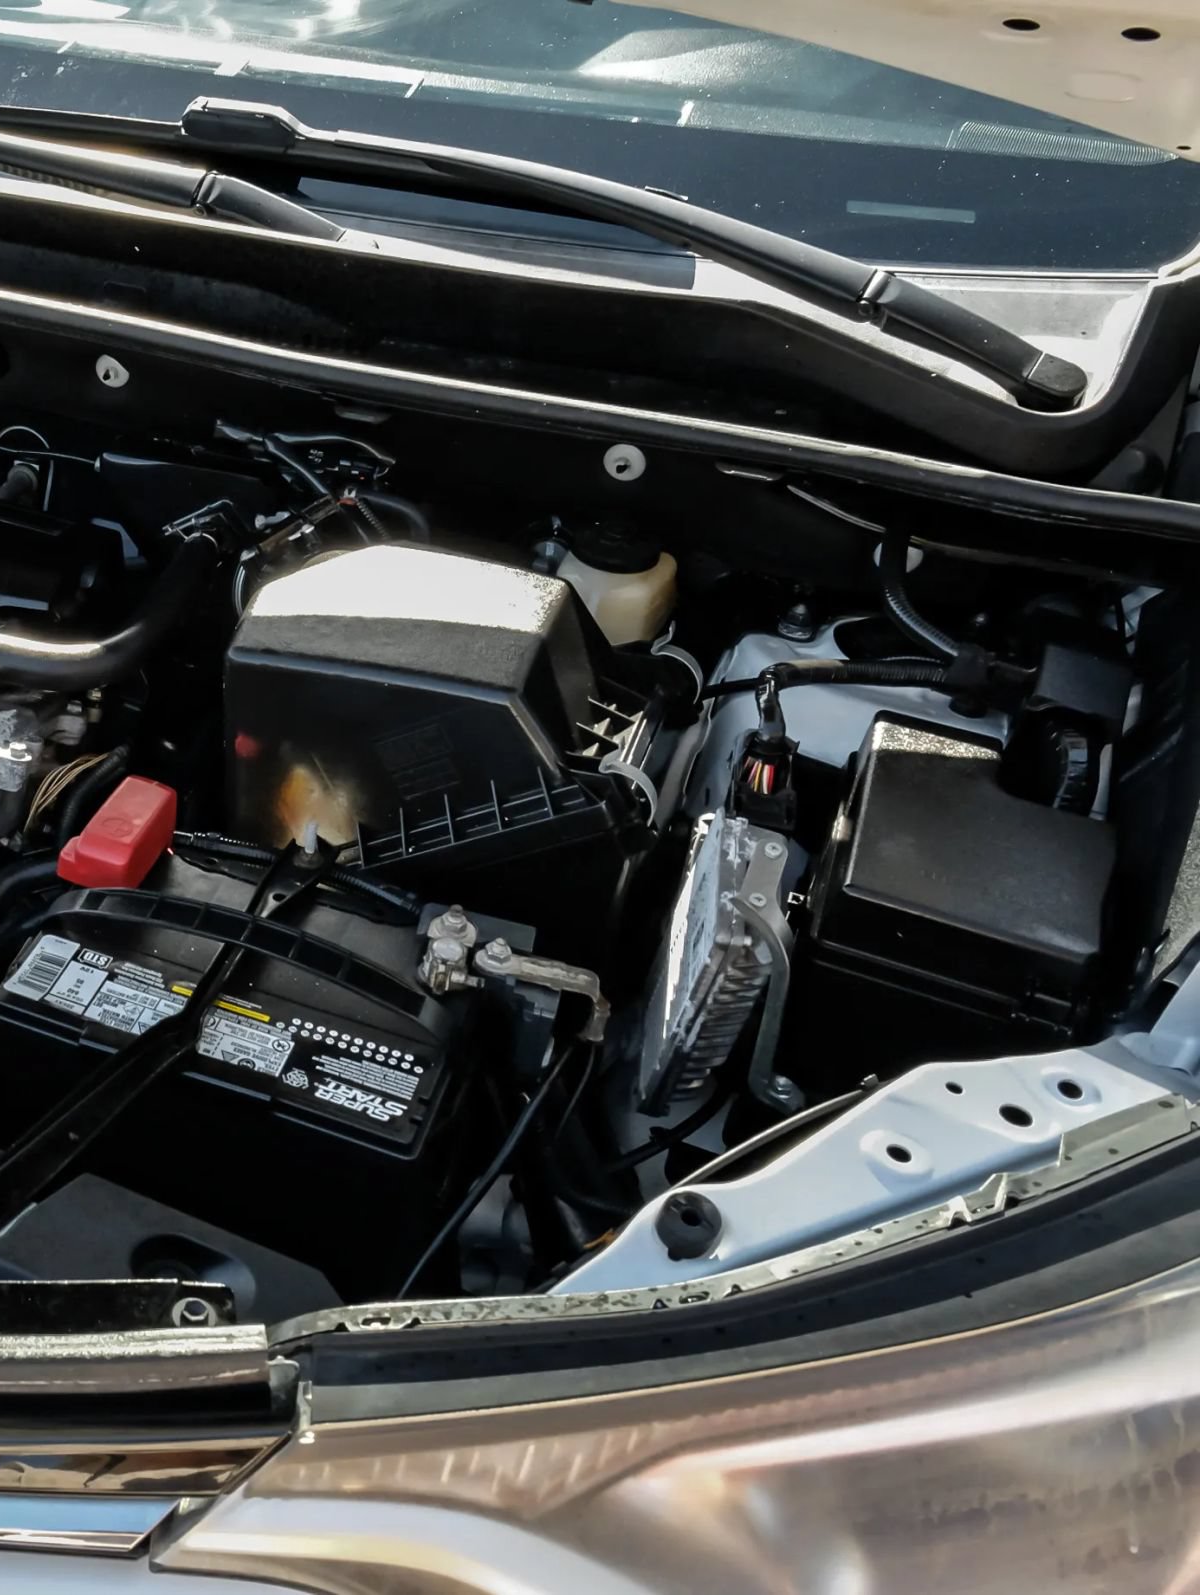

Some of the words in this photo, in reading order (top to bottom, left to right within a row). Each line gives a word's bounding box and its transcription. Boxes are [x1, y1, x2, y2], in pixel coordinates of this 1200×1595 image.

[83, 951, 108, 966] STD
[314, 1089, 390, 1121] SUPER
[317, 1080, 408, 1116] START
